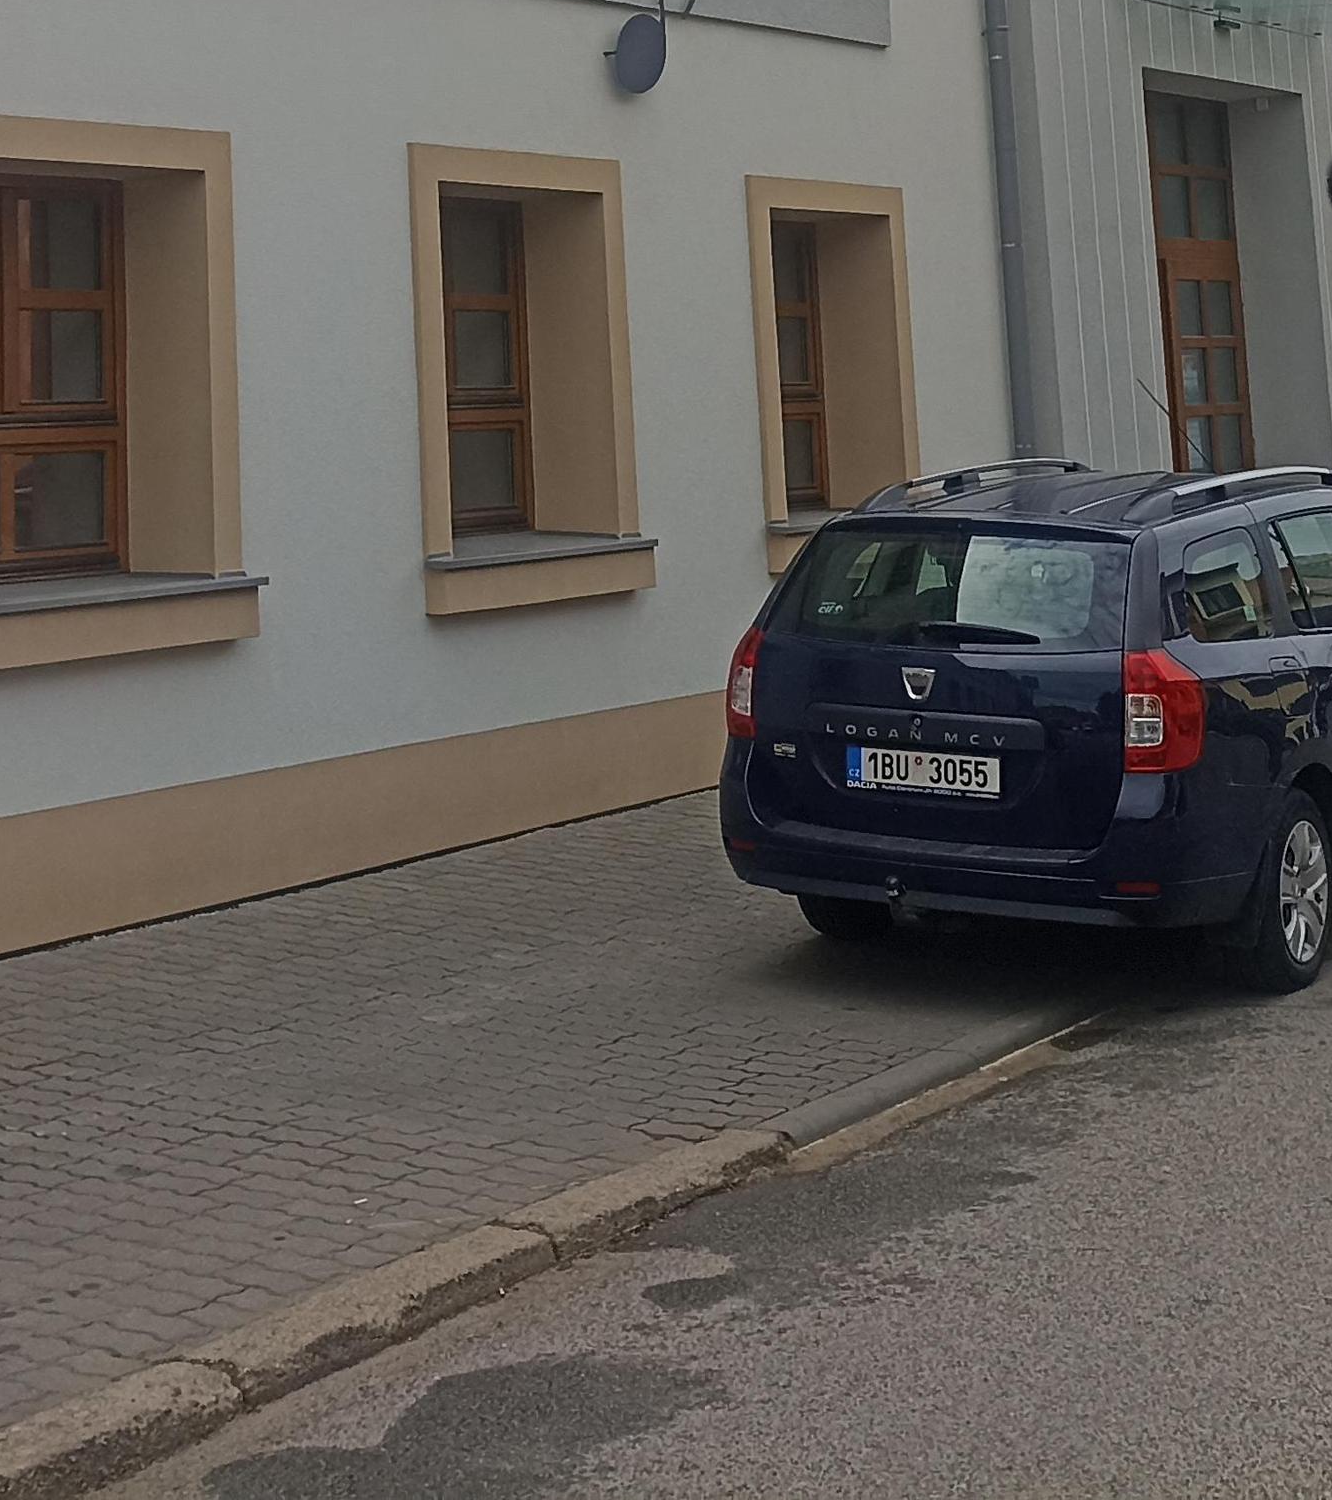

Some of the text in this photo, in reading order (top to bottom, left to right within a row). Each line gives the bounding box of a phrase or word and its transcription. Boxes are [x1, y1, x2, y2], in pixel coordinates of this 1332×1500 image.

[826, 723, 1005, 746] LOGAN MCV
[848, 769, 860, 777] CZ
[868, 752, 988, 788] 1BU 3055
[847, 780, 877, 789] DACIA
